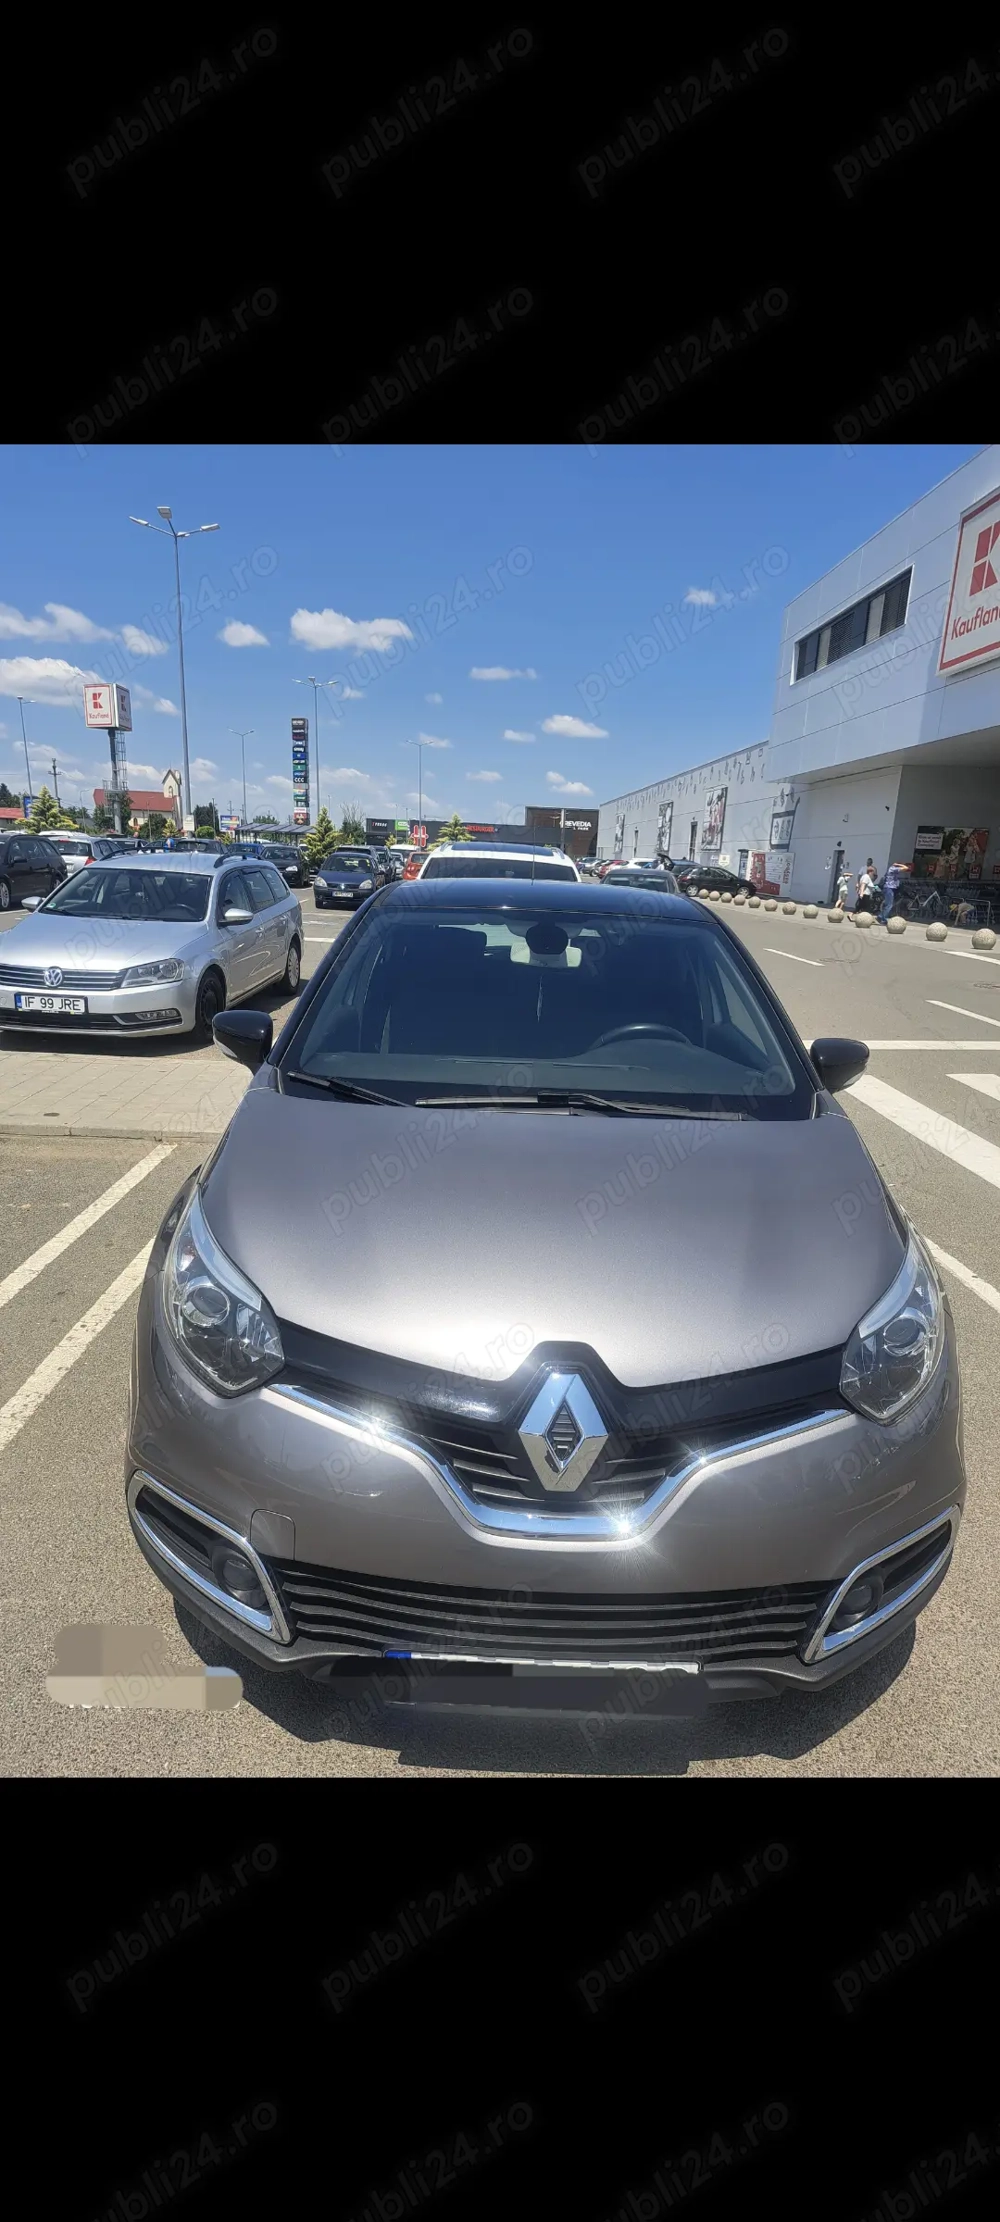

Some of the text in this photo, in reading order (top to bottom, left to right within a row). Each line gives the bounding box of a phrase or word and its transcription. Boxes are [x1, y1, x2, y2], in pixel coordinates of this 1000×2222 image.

[951, 605, 1000, 641] Kauflan
[24, 996, 82, 1011] IF 99 JRE
